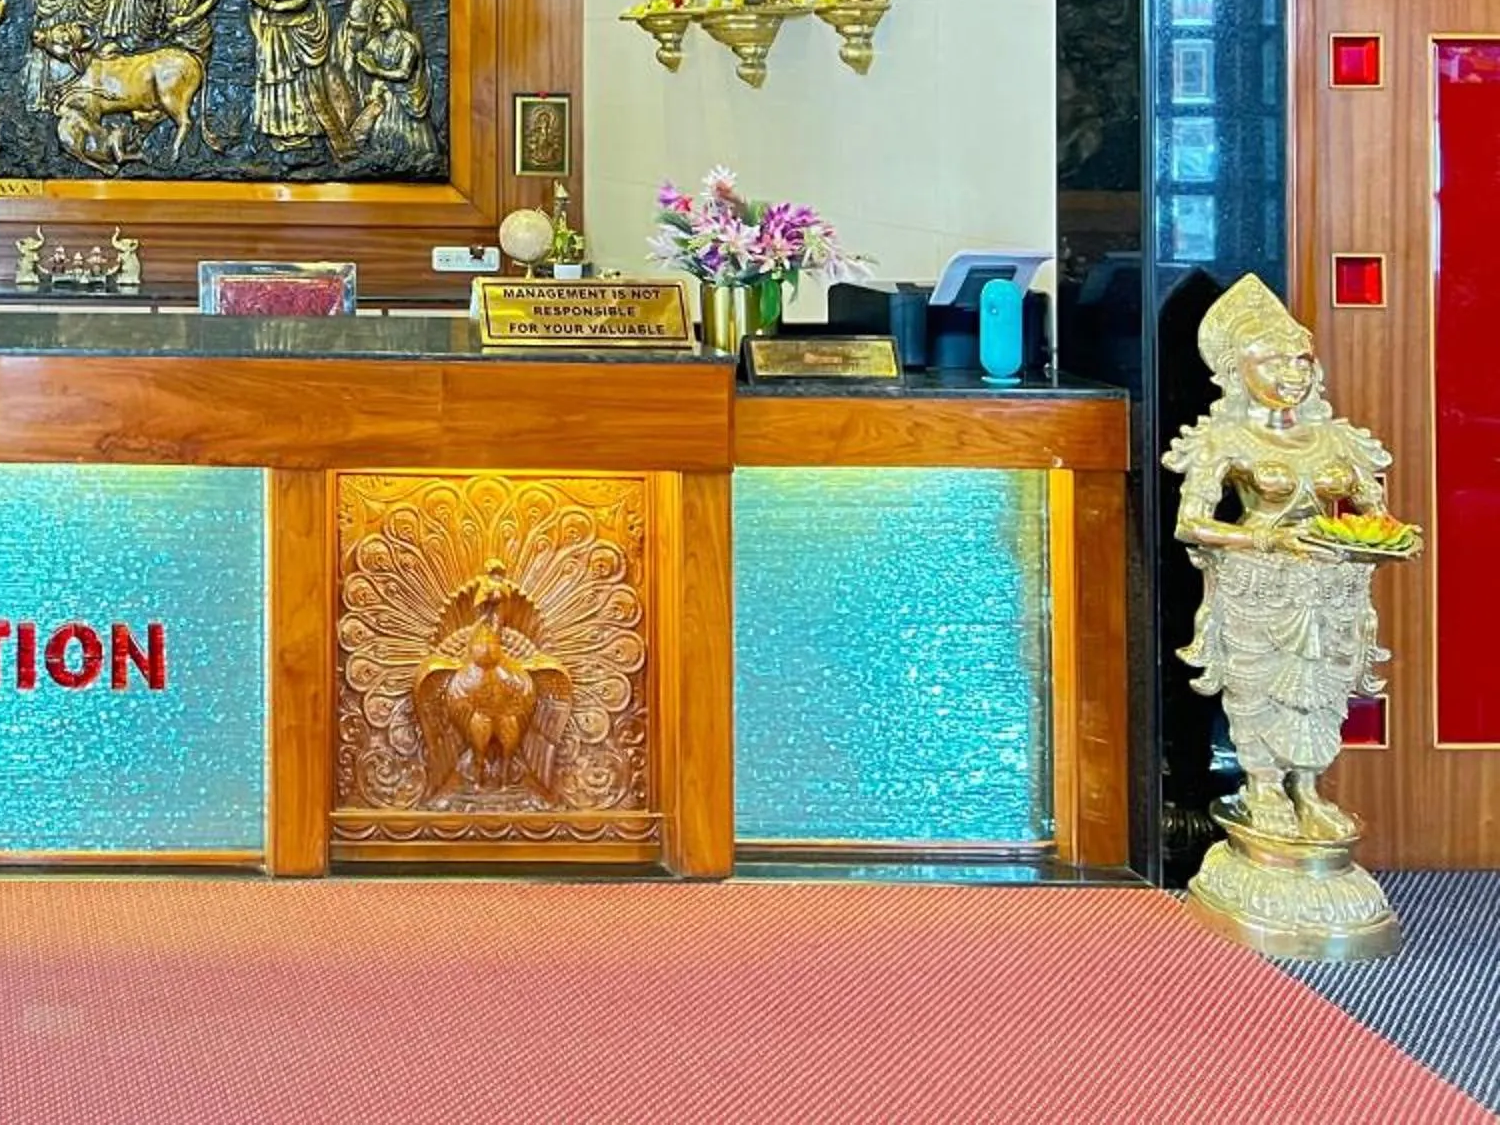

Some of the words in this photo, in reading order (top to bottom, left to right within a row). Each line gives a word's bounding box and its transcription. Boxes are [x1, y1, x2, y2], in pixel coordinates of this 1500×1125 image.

[503, 288, 607, 300] MANAGEMENT
[612, 289, 627, 300] IS
[632, 289, 661, 300] NOT
[533, 305, 636, 316] RESPONSIBLE
[509, 322, 539, 334] FOR
[544, 323, 584, 334] YOUR
[590, 323, 665, 335] VALUABLE
